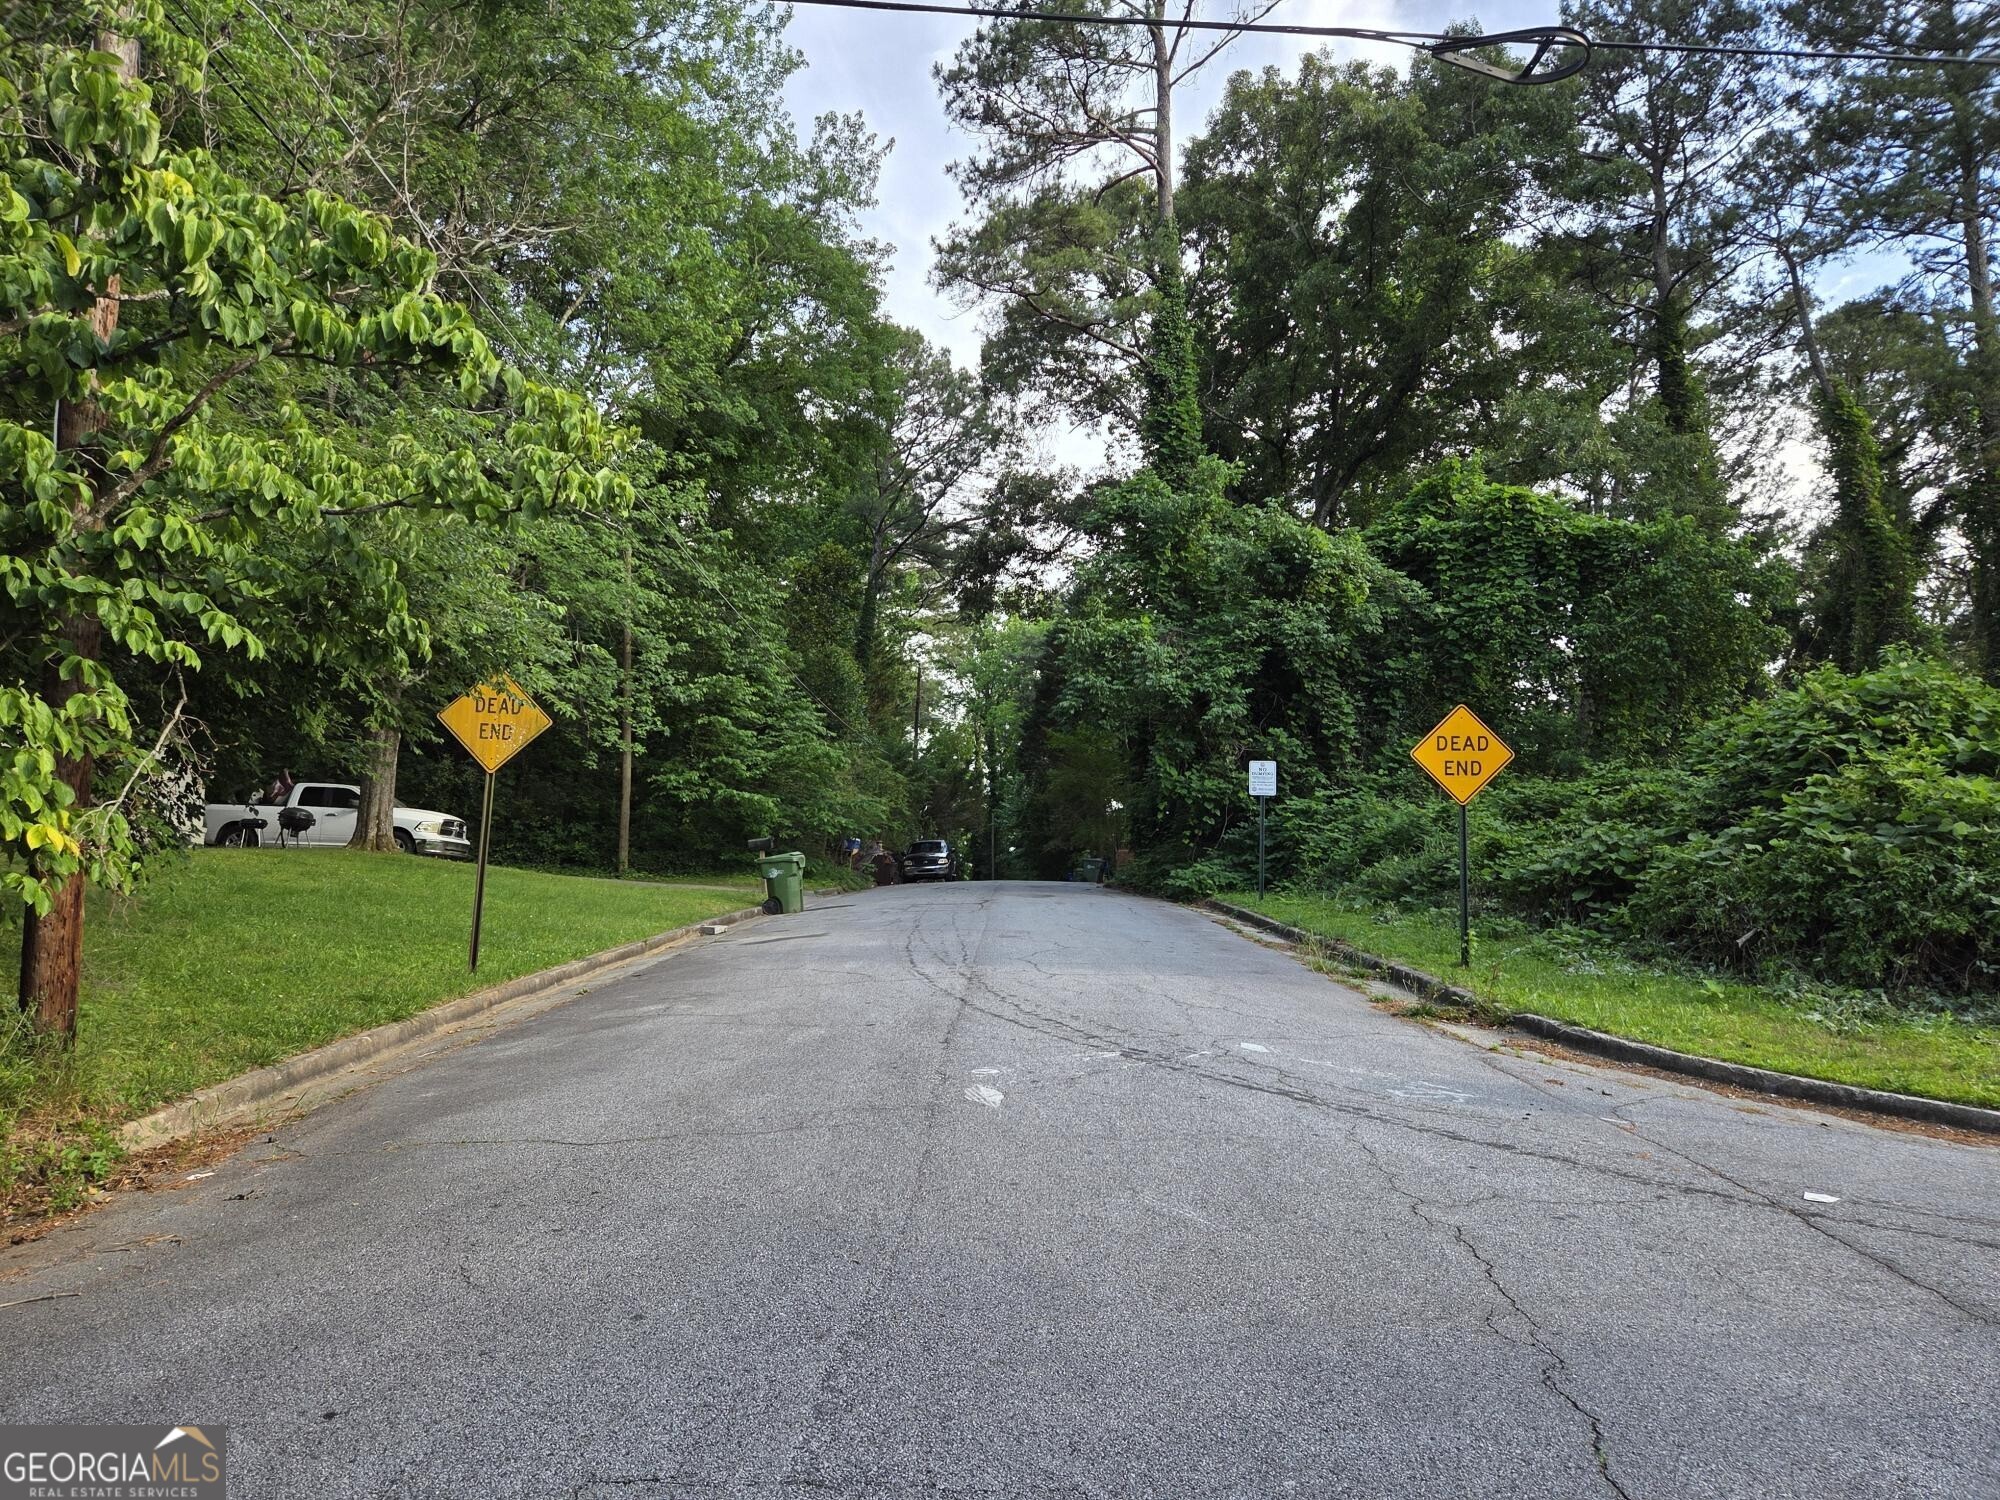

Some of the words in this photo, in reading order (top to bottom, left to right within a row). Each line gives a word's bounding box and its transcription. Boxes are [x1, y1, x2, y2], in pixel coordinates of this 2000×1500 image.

[475, 697, 521, 715] DEAD
[479, 723, 512, 740] END
[1436, 735, 1489, 751] DEAD
[1444, 760, 1482, 776] END
